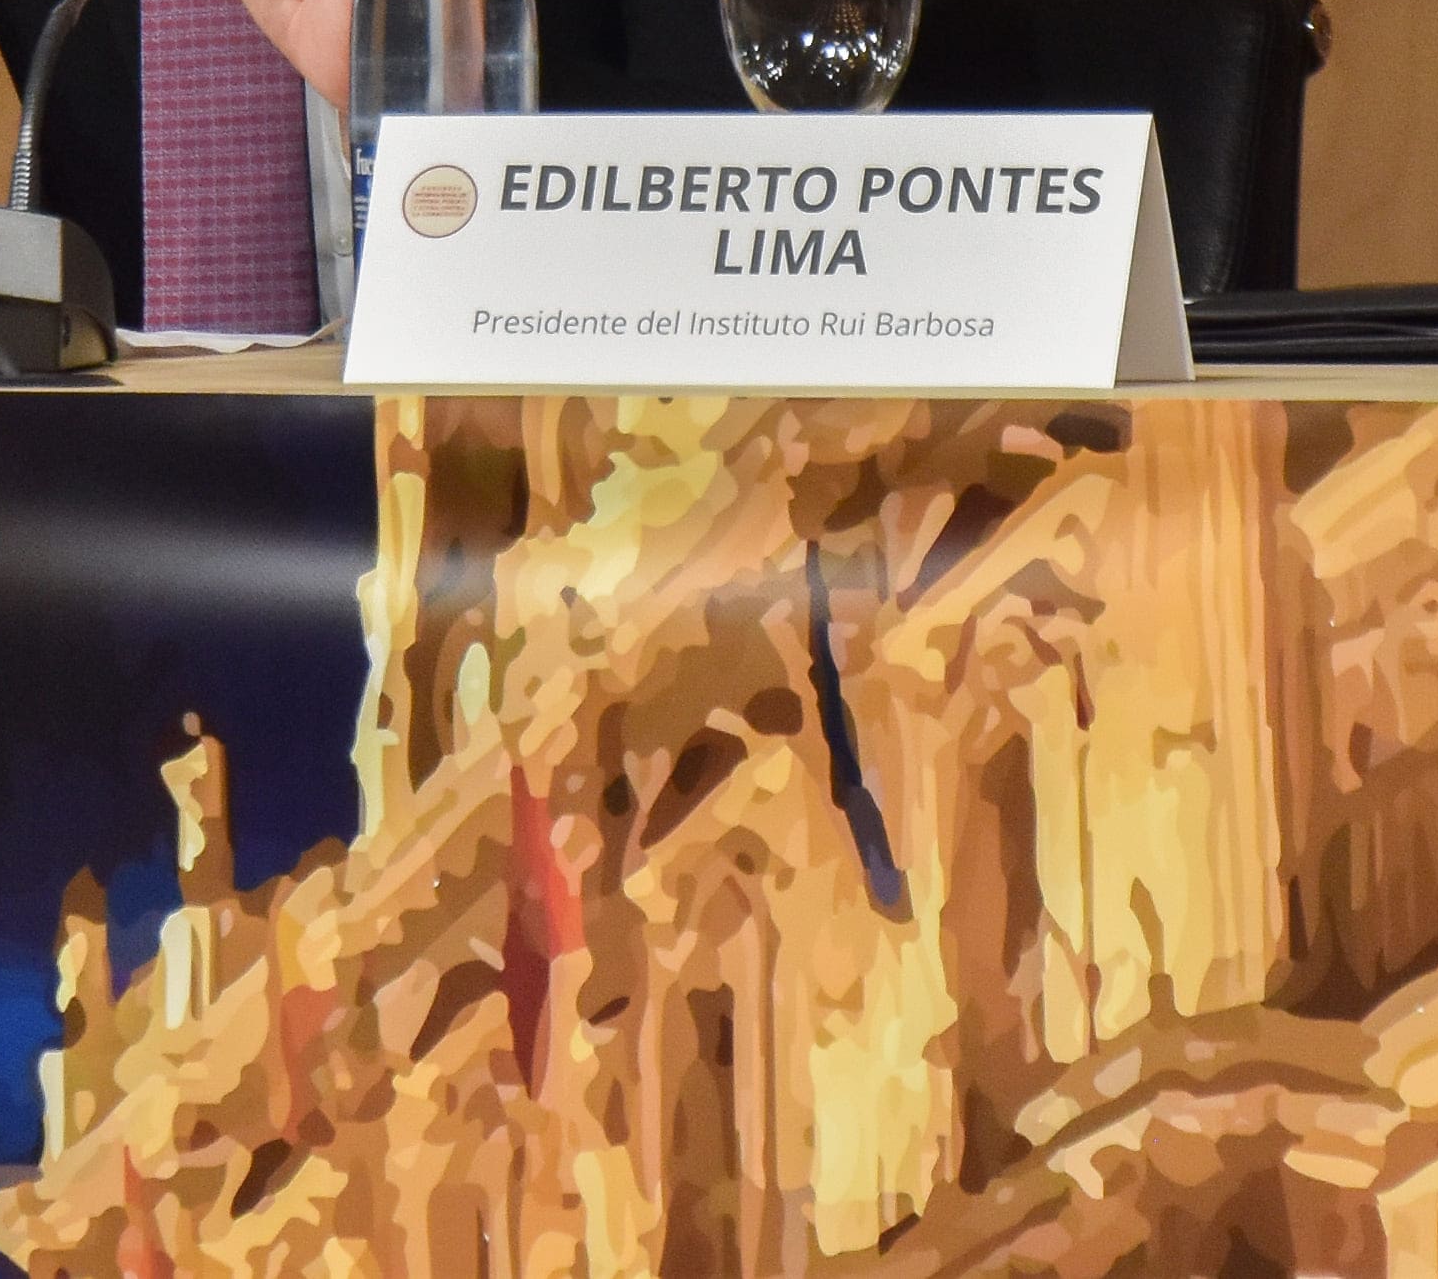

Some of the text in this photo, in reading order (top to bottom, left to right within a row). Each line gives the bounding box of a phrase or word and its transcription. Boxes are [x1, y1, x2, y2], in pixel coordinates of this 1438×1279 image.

[500, 164, 839, 214] EDILBERTO
[858, 166, 1105, 214] PONTES
[713, 228, 868, 275] LIMA
[472, 309, 996, 337] Presidente del Instituto Rui Barbosa
